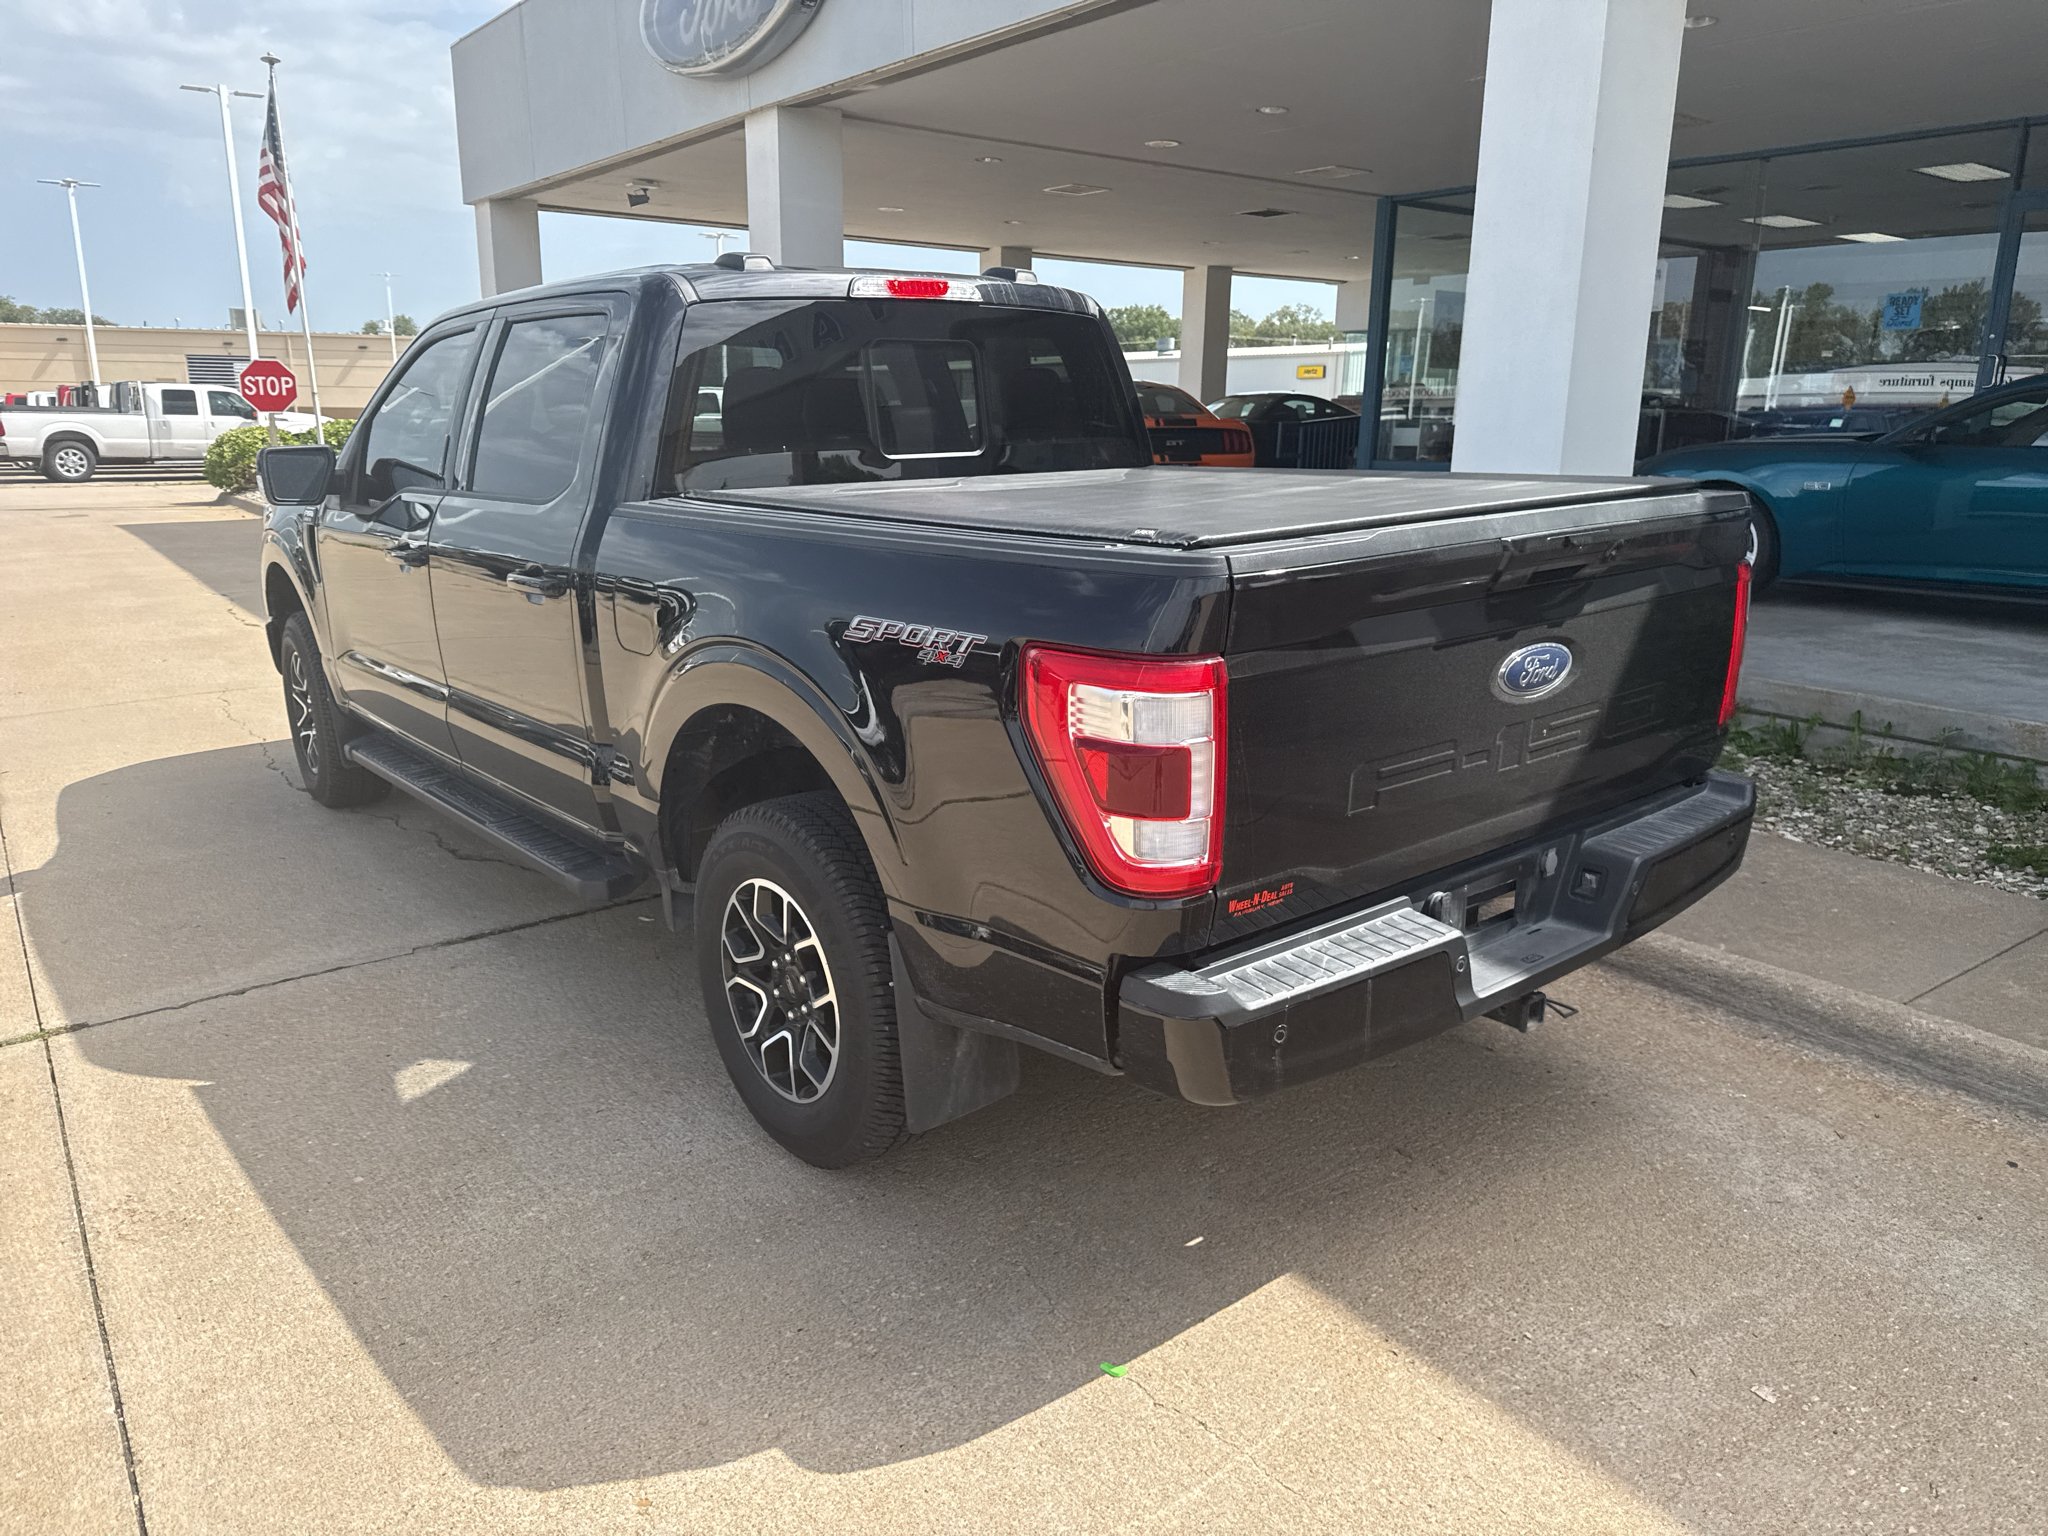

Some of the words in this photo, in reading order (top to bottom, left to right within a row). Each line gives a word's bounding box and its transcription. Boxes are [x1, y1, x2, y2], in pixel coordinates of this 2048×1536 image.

[1889, 296, 1920, 306] READY
[1894, 305, 1910, 316] SET
[244, 375, 294, 396] STOP
[843, 615, 988, 656] SPORT
[917, 649, 965, 668] 4x4
[1520, 654, 1560, 687] Ford
